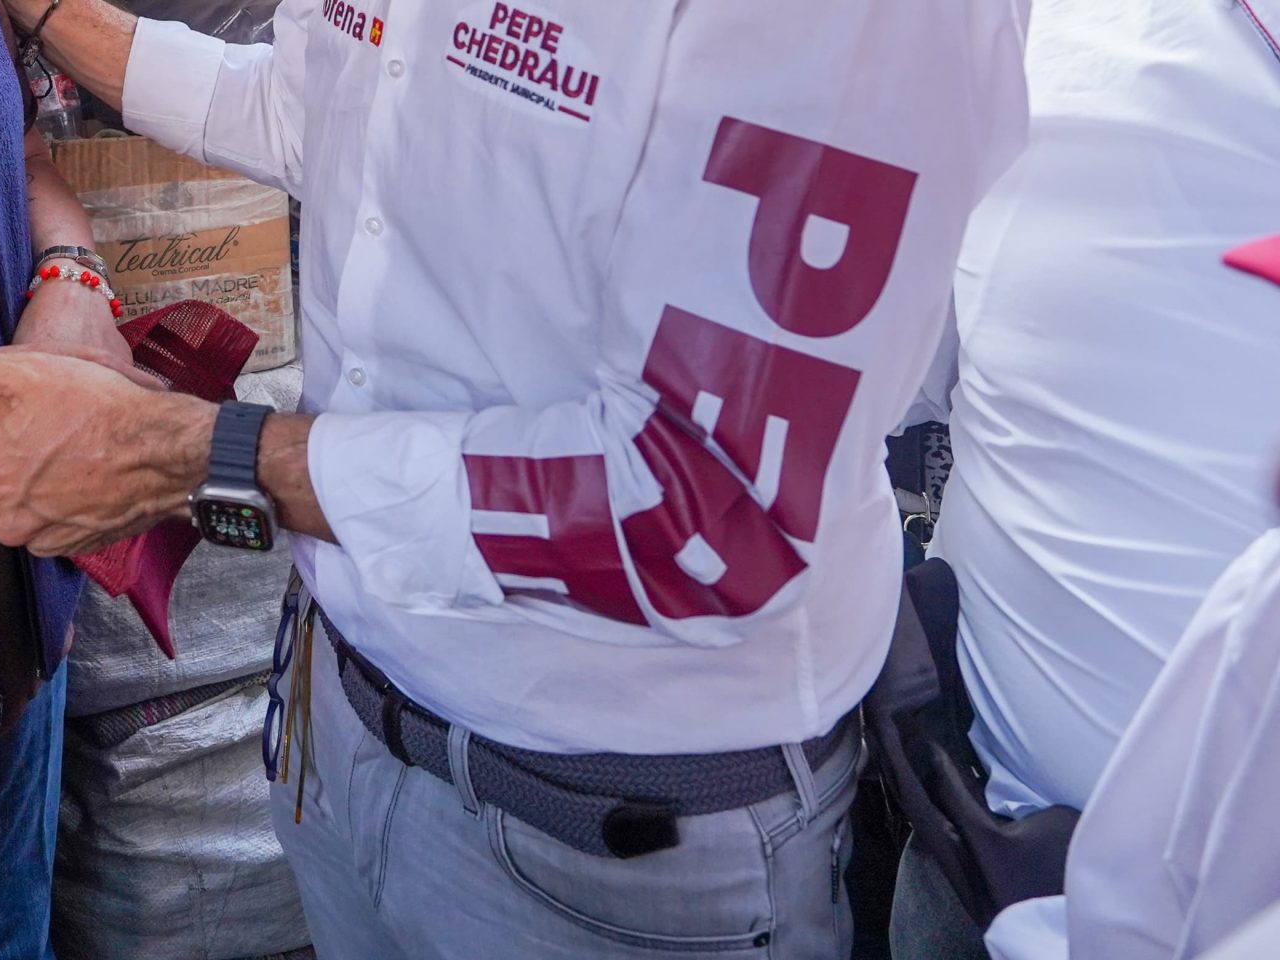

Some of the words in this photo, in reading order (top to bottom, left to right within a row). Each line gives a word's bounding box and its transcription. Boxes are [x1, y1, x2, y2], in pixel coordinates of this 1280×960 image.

[489, 1, 564, 54] PEPE
[453, 21, 600, 106] CHEDRAUI
[465, 63, 510, 91] PRESIDENTE
[115, 224, 241, 274] Teatrical
[151, 265, 178, 277] Crema
[178, 262, 210, 275] Corporal
[191, 275, 259, 297] MADRE
